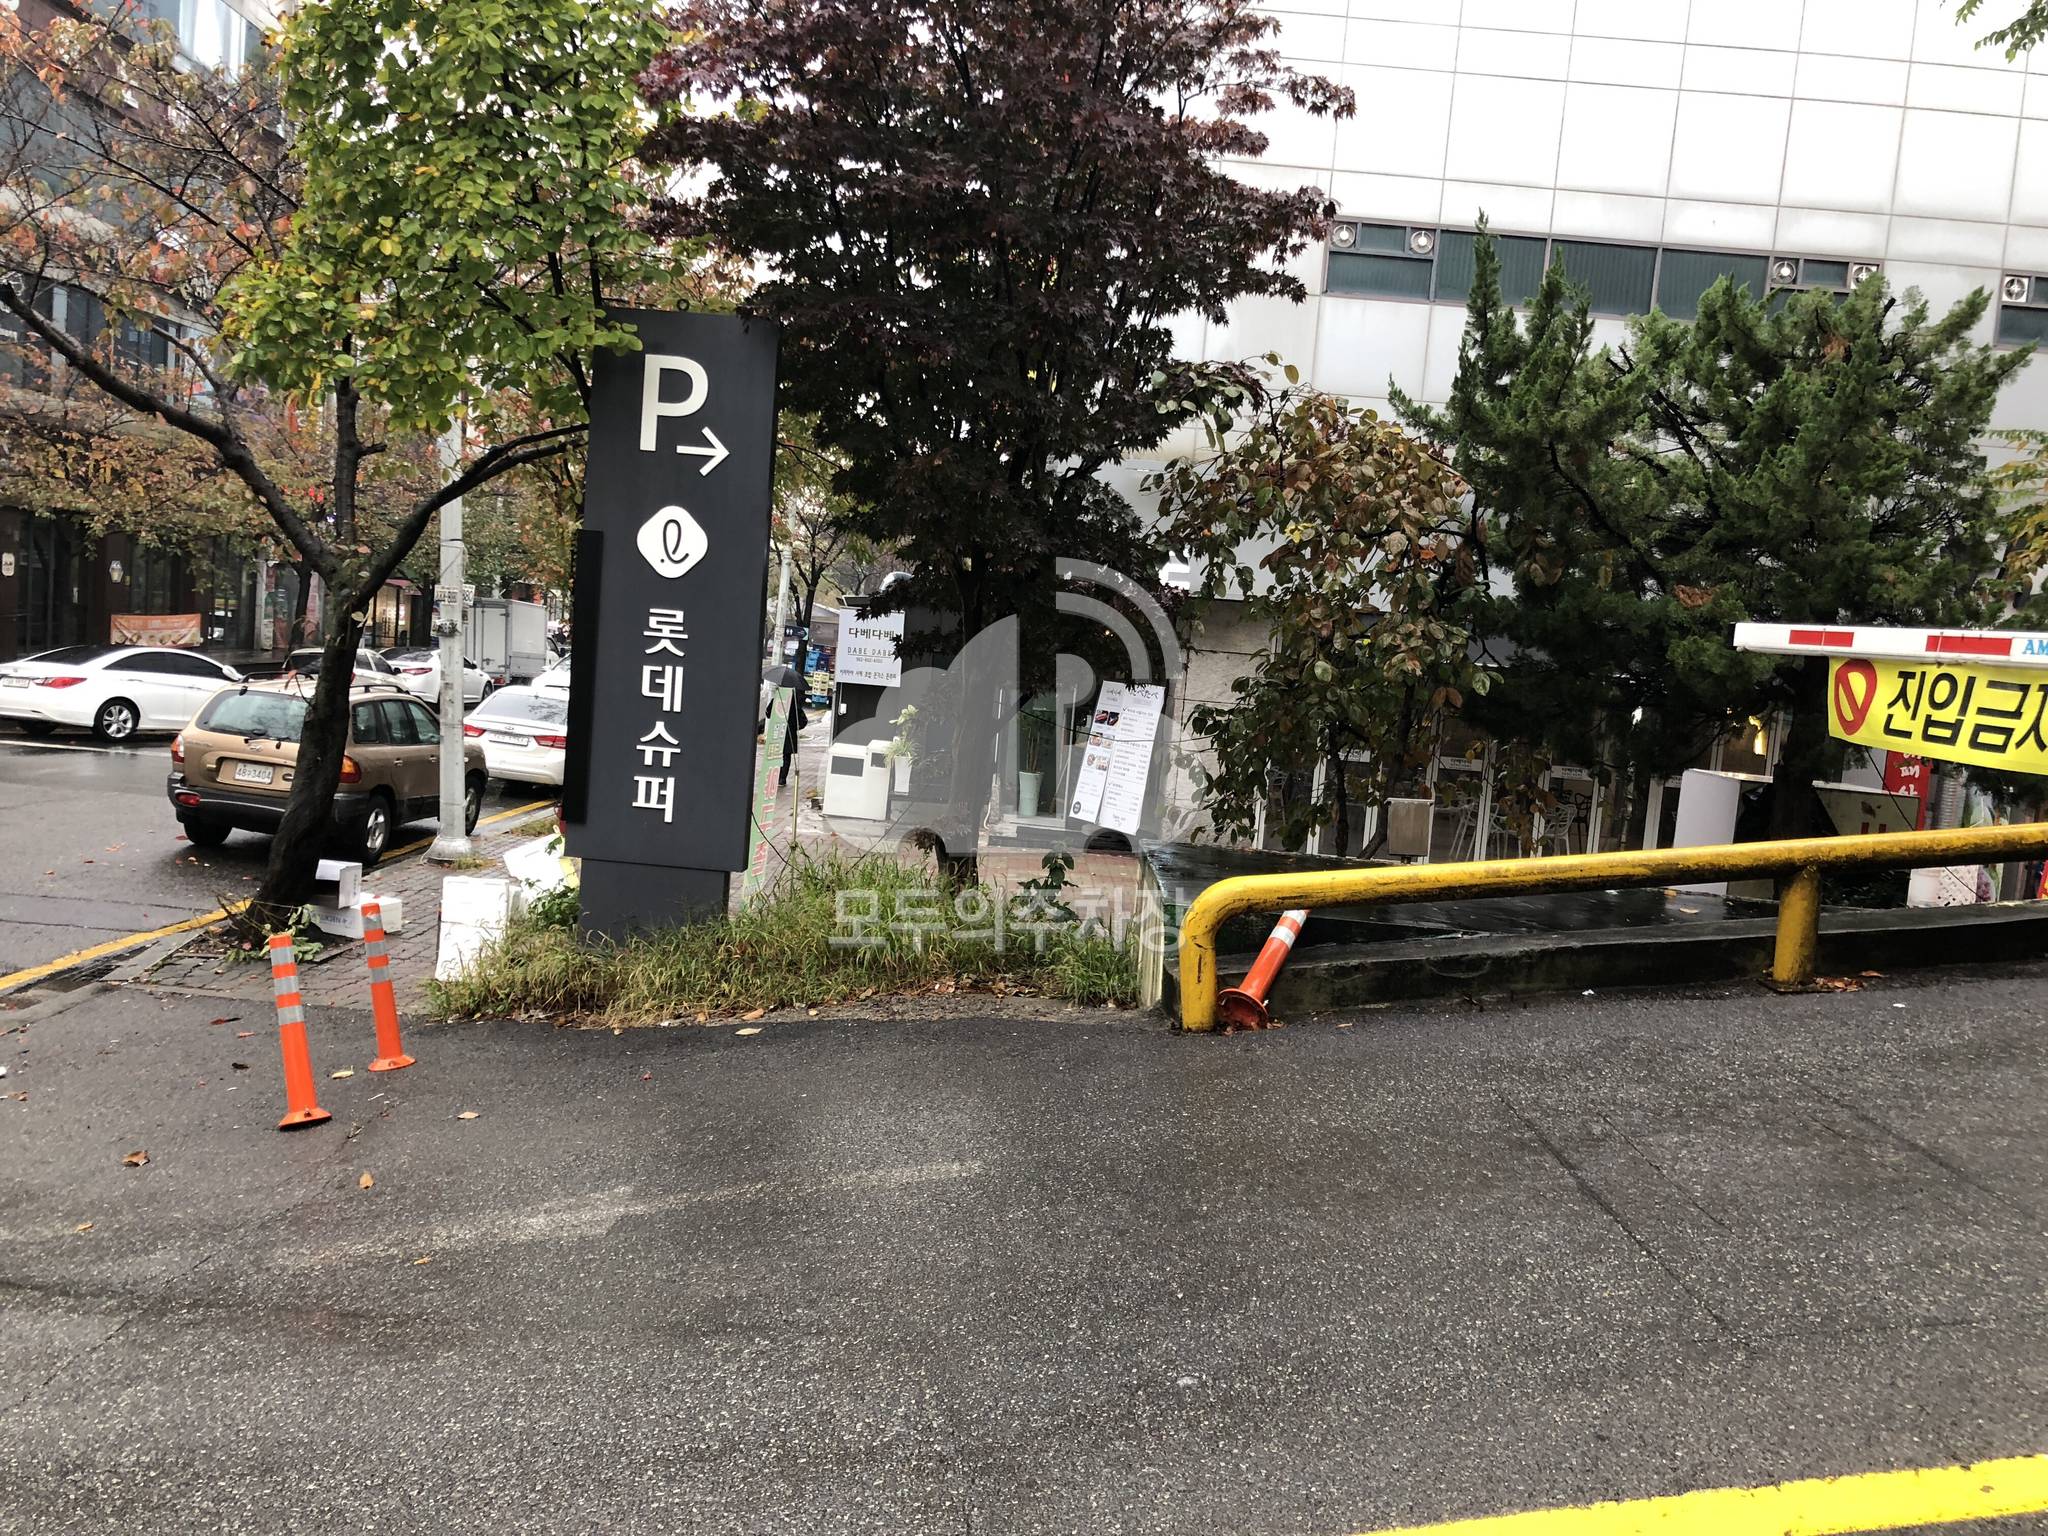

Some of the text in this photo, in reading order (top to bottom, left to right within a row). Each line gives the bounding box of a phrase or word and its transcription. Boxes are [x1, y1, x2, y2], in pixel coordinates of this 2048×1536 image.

[640, 354, 708, 451] P
[848, 627, 895, 640] 다베다베
[632, 608, 688, 823] 롯데슈퍼
